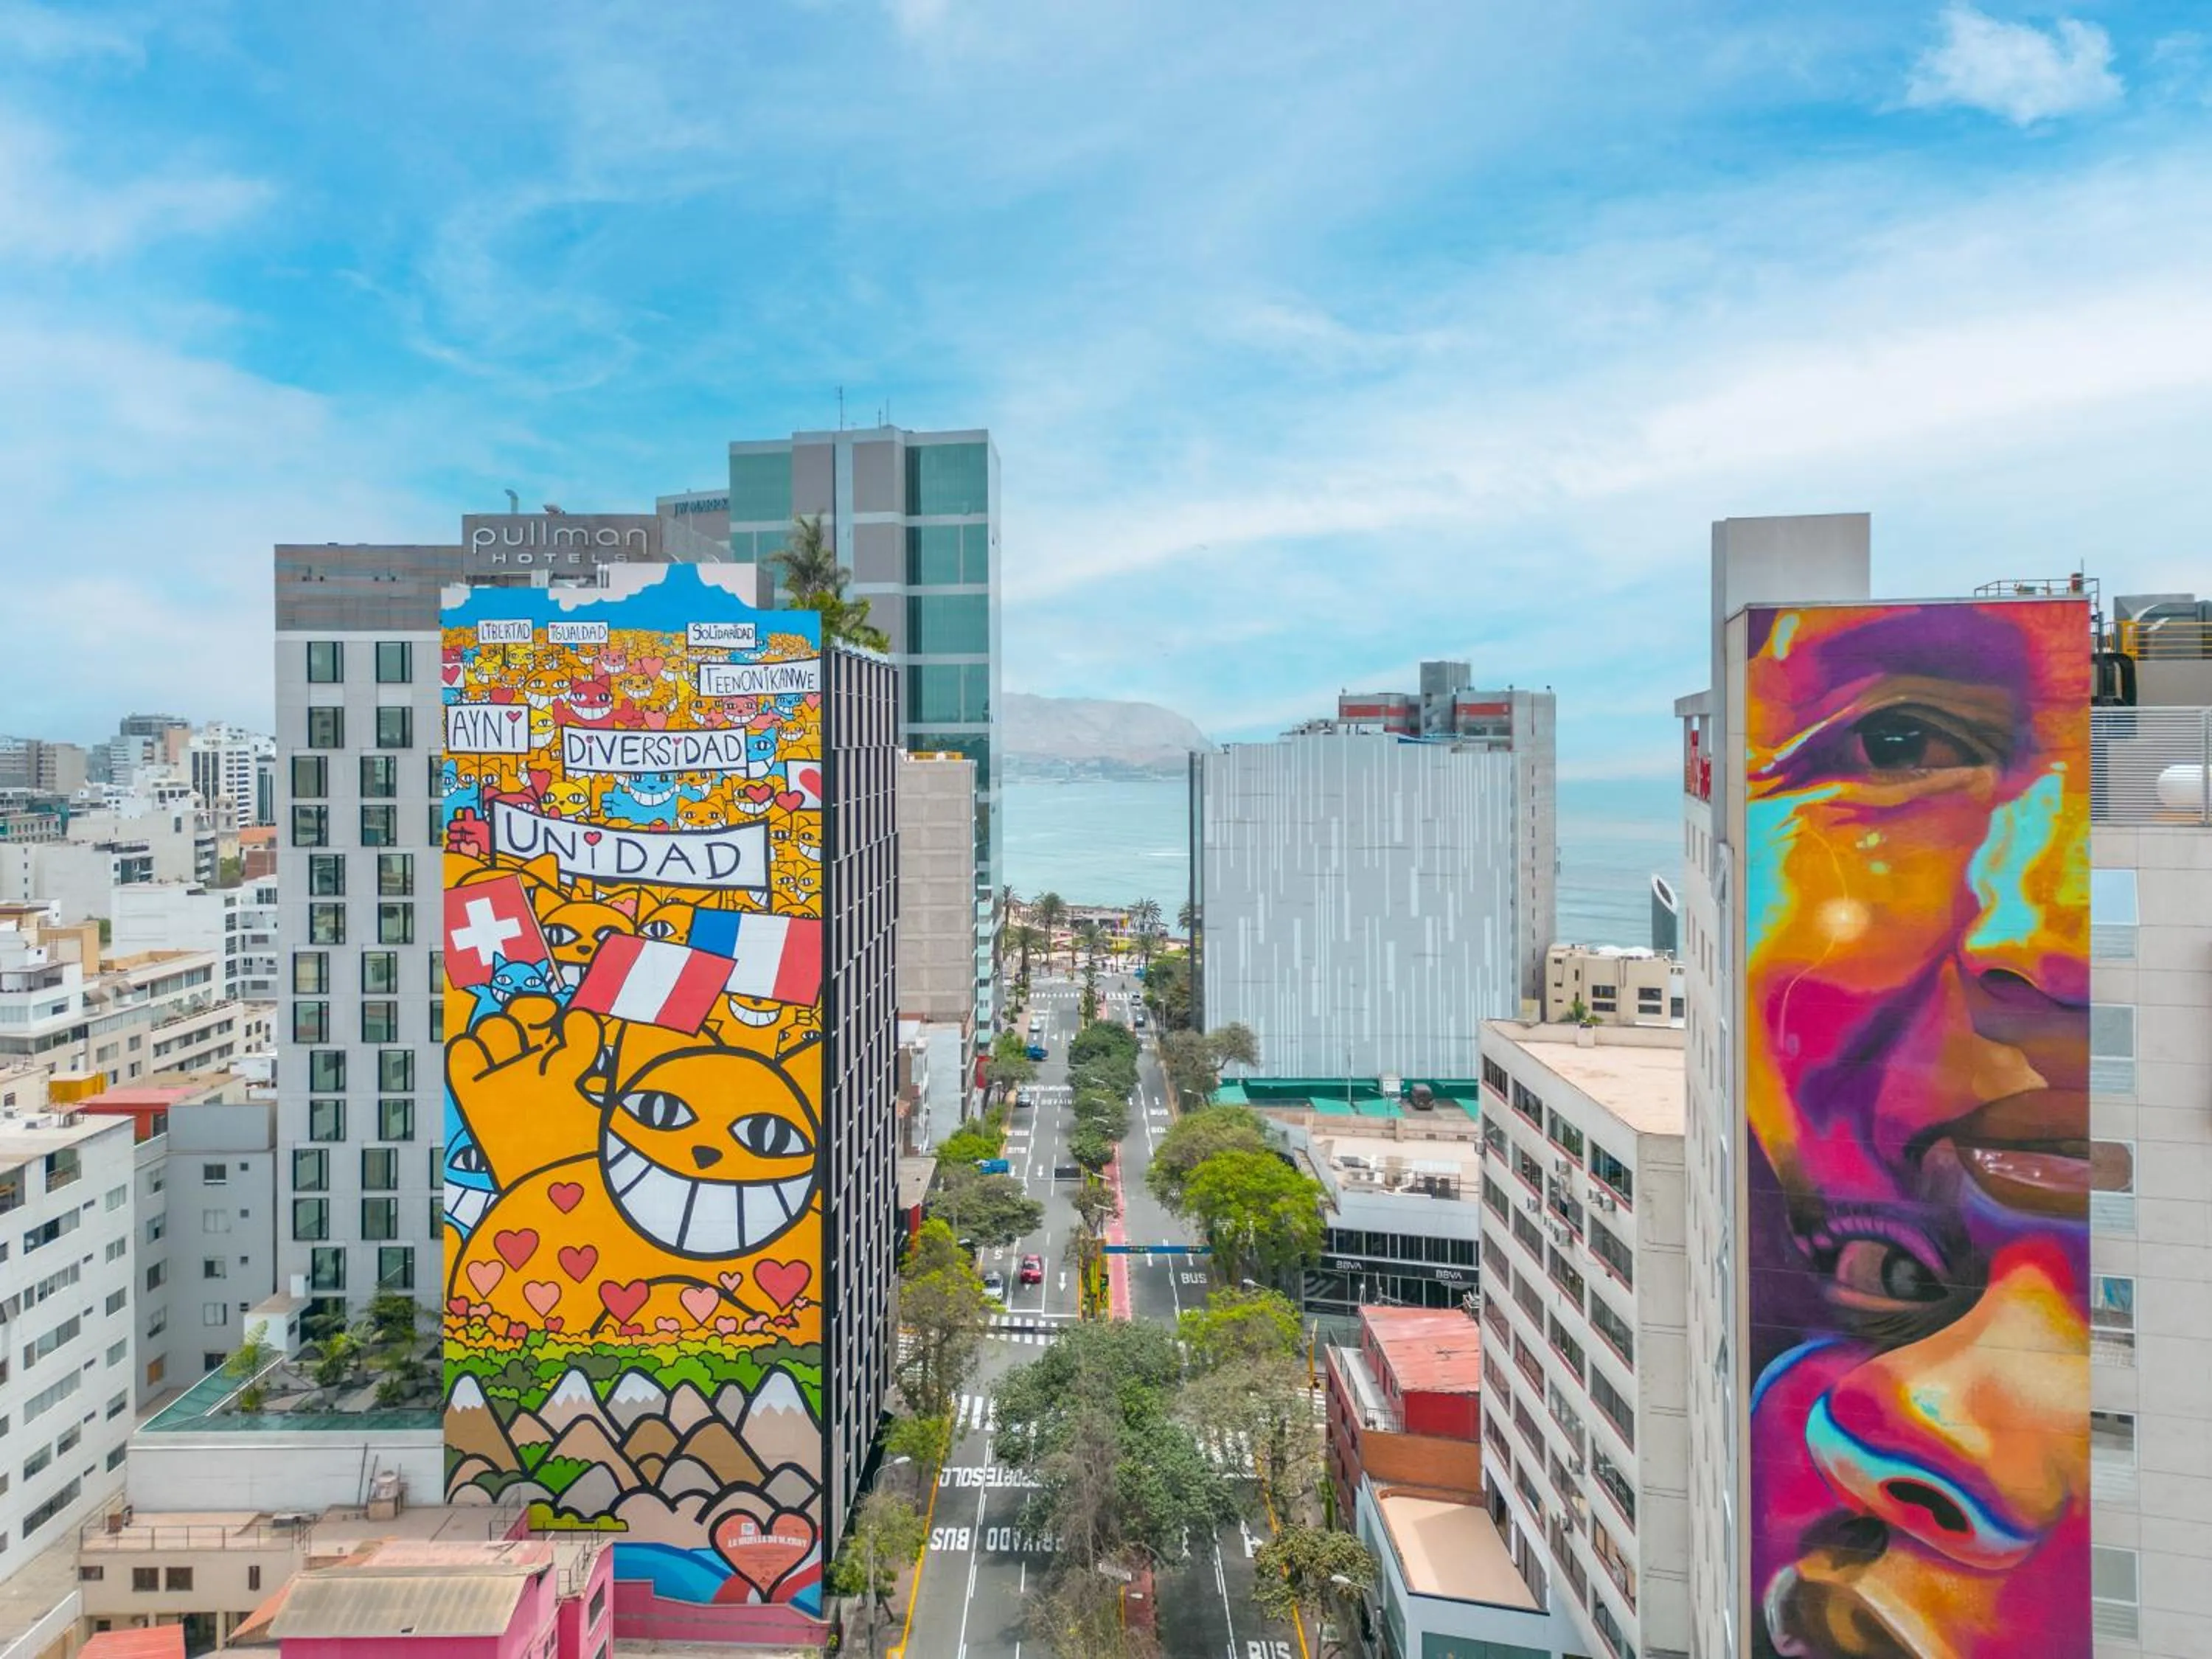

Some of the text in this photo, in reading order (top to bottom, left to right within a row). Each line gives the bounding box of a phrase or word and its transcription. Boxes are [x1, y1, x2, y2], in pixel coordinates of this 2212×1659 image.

[473, 521, 647, 554] pullman
[492, 554, 630, 564] HOTELS
[1336, 1260, 1363, 1270] BBVA
[1181, 1272, 1207, 1284] BUS
[1436, 1270, 1462, 1280] BBVA
[939, 1467, 984, 1487] SOLO
[930, 1527, 970, 1551] BUS
[1247, 1641, 1292, 1659] BUS
